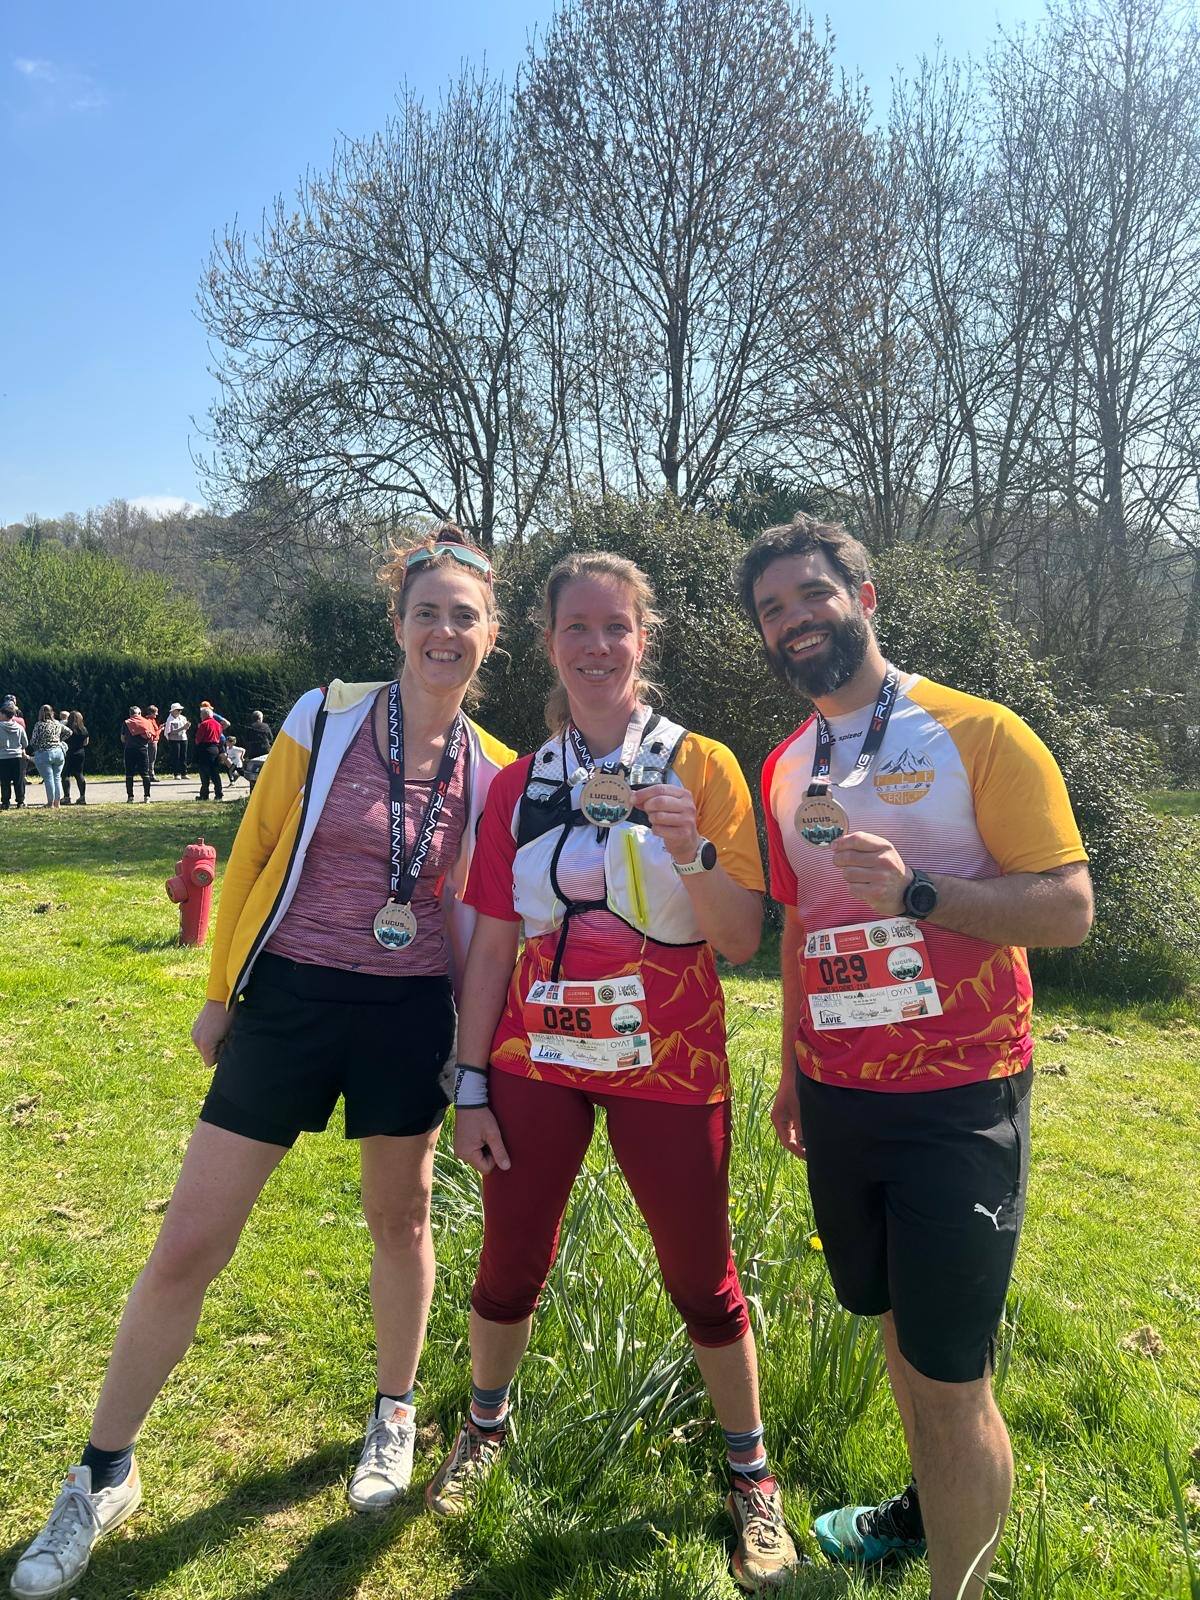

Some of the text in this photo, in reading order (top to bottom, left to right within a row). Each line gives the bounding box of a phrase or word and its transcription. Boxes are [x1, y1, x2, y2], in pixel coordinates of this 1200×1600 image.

[389, 683, 400, 762] RUNNING
[838, 731, 864, 742] spized
[590, 793, 618, 801] LUCUS
[801, 815, 832, 824] LUCUS
[411, 793, 445, 879] RUNNING
[391, 800, 401, 892] RUNNING
[381, 919, 405, 928] LUCUS
[819, 954, 868, 986] 029
[891, 987, 912, 997] OYAT
[543, 1006, 592, 1032] 026
[610, 1040, 631, 1049] OYAT
